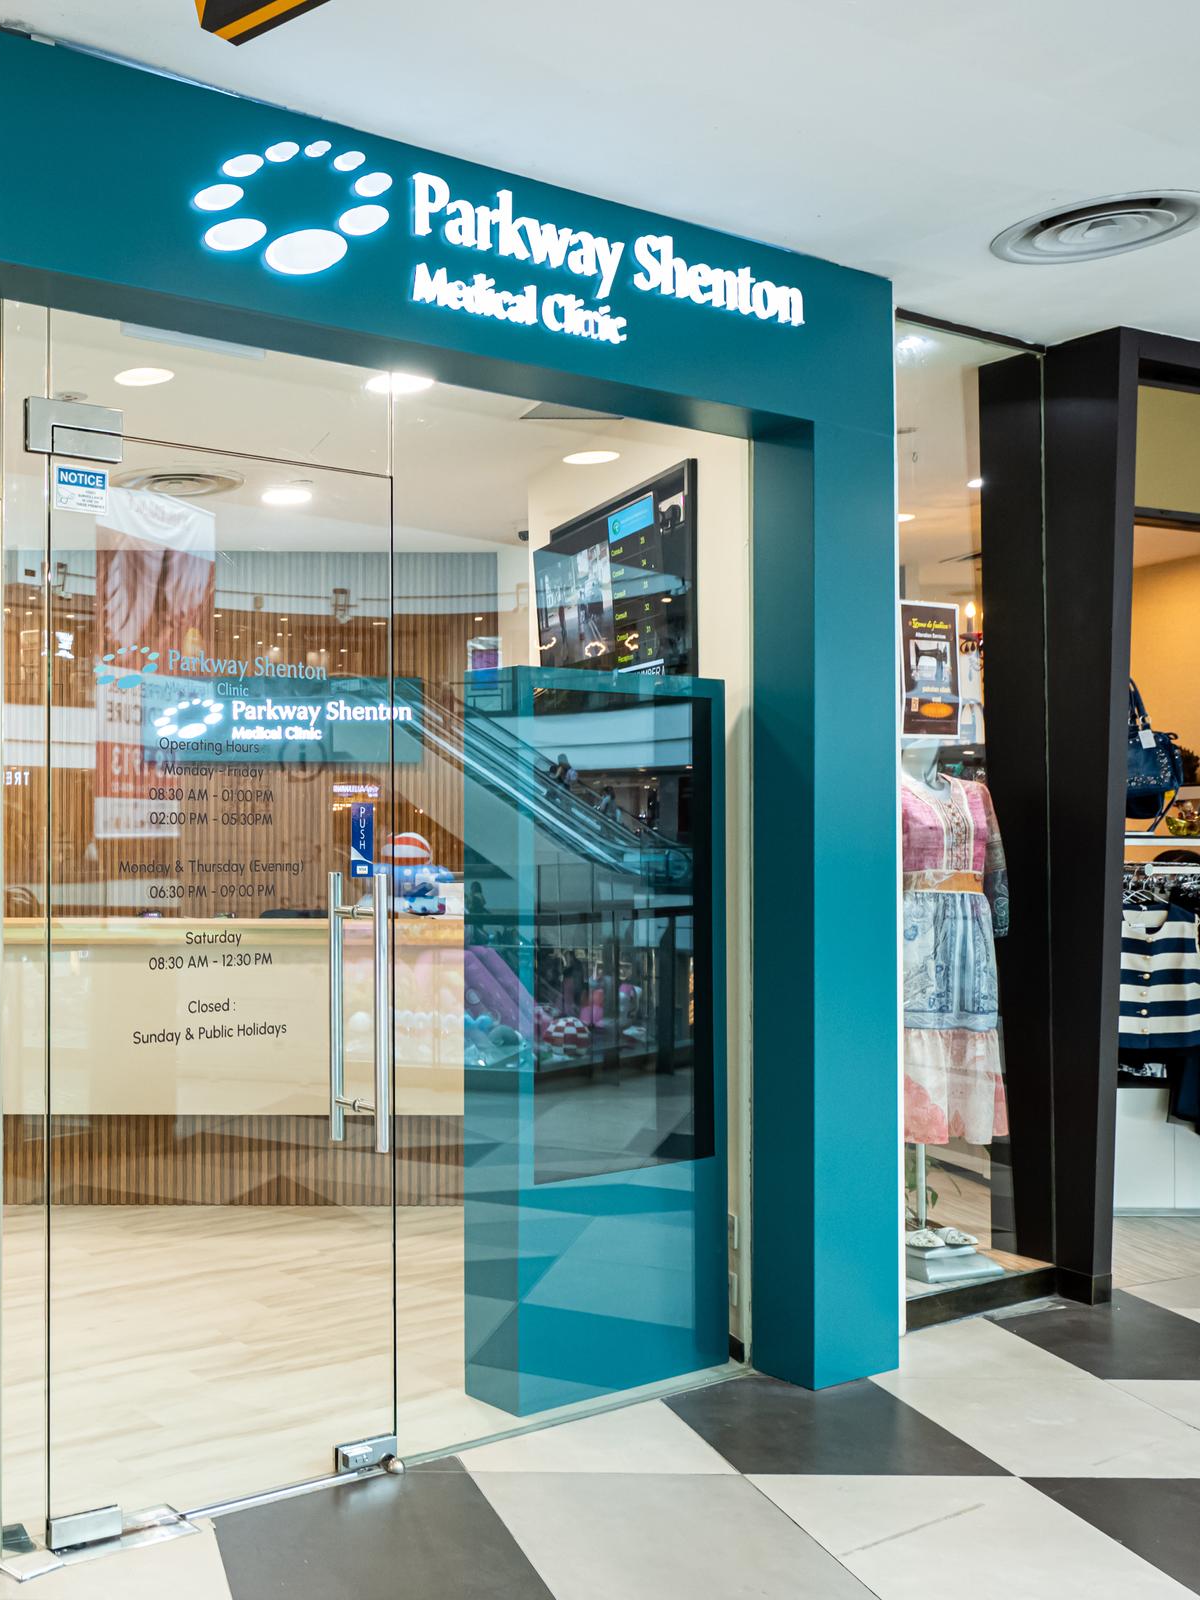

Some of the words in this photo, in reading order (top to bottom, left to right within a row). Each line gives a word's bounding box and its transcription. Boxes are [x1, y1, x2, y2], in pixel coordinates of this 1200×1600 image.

[411, 172, 625, 298] Parkway
[633, 234, 806, 325] Shenton
[412, 262, 536, 325] Medical
[542, 292, 628, 344] Clinic
[60, 471, 103, 487] NOTICE
[168, 649, 248, 681] Parkway
[254, 656, 327, 681] Shenton
[217, 682, 249, 697] Clinic
[232, 700, 321, 727] Parkway
[326, 700, 412, 721] Shenton
[232, 726, 282, 740] Medical
[285, 726, 322, 740] Clinic
[159, 737, 223, 756] Operating
[226, 740, 260, 754] Hours
[164, 763, 217, 780] Monday
[227, 765, 264, 780] Friday
[148, 788, 184, 802] 08:30
[187, 788, 208, 802] AM
[221, 789, 253, 803] 01:00
[256, 790, 274, 803] PM
[149, 811, 186, 825] 02:00
[189, 812, 208, 825] PM
[118, 860, 171, 875] Monday
[175, 861, 184, 874] &
[188, 860, 245, 876] Thursday
[249, 859, 305, 876] (Evening)
[149, 885, 185, 899] 06:30
[188, 885, 207, 898] PM
[220, 884, 253, 898] 09:00
[257, 884, 275, 897] PM
[185, 930, 242, 947] Saturday
[148, 956, 184, 971] 08:30
[187, 955, 208, 969] AM
[221, 953, 251, 968] 12:30
[254, 952, 273, 966] PM
[187, 998, 230, 1014] Closed
[133, 1029, 181, 1047] Sunday
[185, 1028, 195, 1041] &
[198, 1024, 234, 1040] Public
[237, 1022, 287, 1039] Holidays
